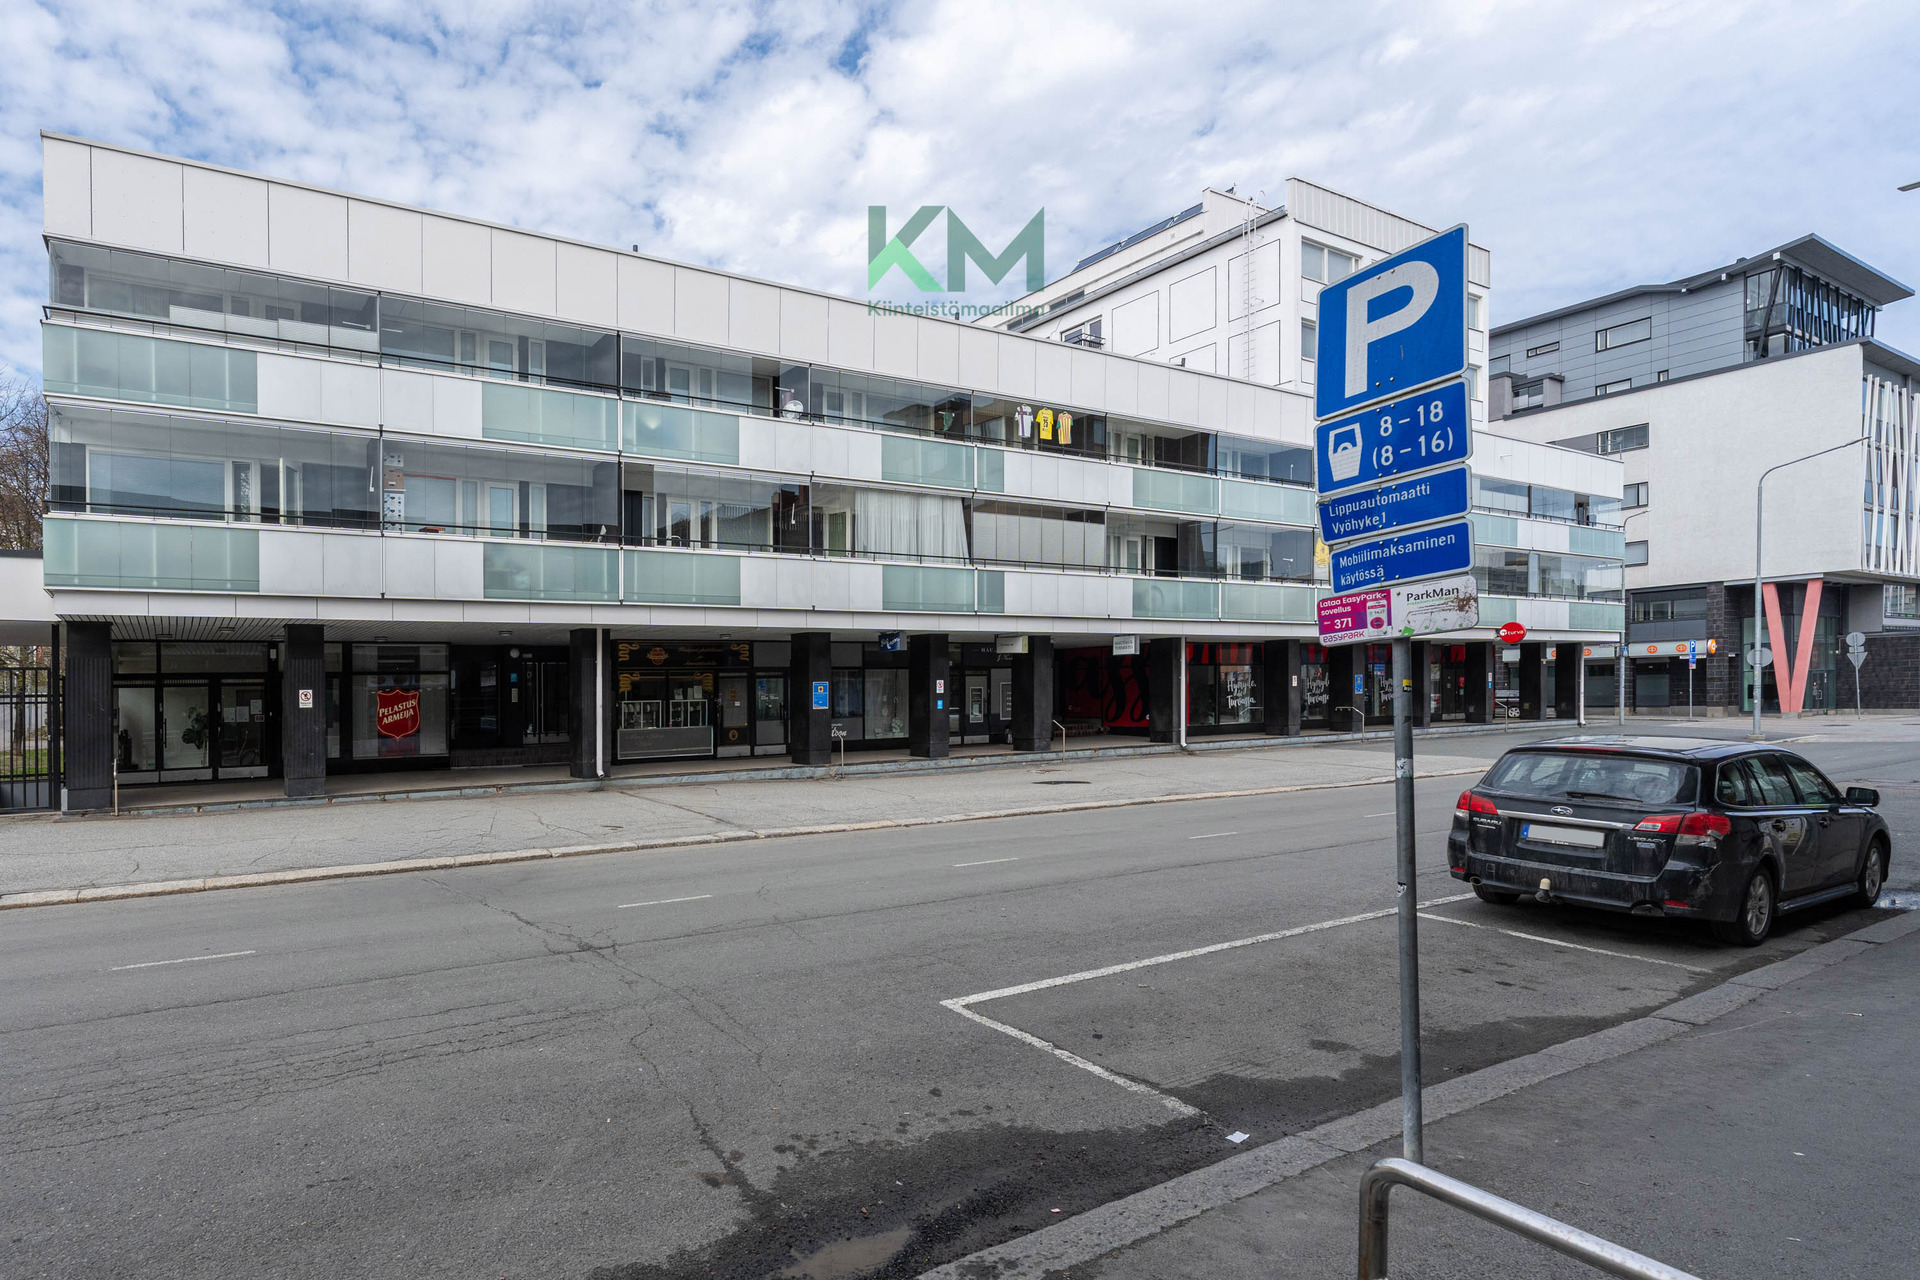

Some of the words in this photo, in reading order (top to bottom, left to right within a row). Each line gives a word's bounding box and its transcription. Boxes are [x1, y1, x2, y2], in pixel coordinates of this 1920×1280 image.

[1345, 260, 1440, 399] P
[1329, 482, 1431, 517] Lippuautomaatti
[1339, 534, 1456, 569] Mobiilimaksaminen
[1340, 565, 1385, 587] käytössä
[1406, 587, 1459, 602] ParkMan
[1319, 600, 1341, 608] Lataa
[1320, 605, 1352, 616] sovellus
[1334, 617, 1352, 629] 371
[1690, 641, 1696, 652] P
[379, 698, 417, 718] PELASTUS
[381, 709, 414, 725] ARMEIJA
[1472, 816, 1502, 825] SUBARU
